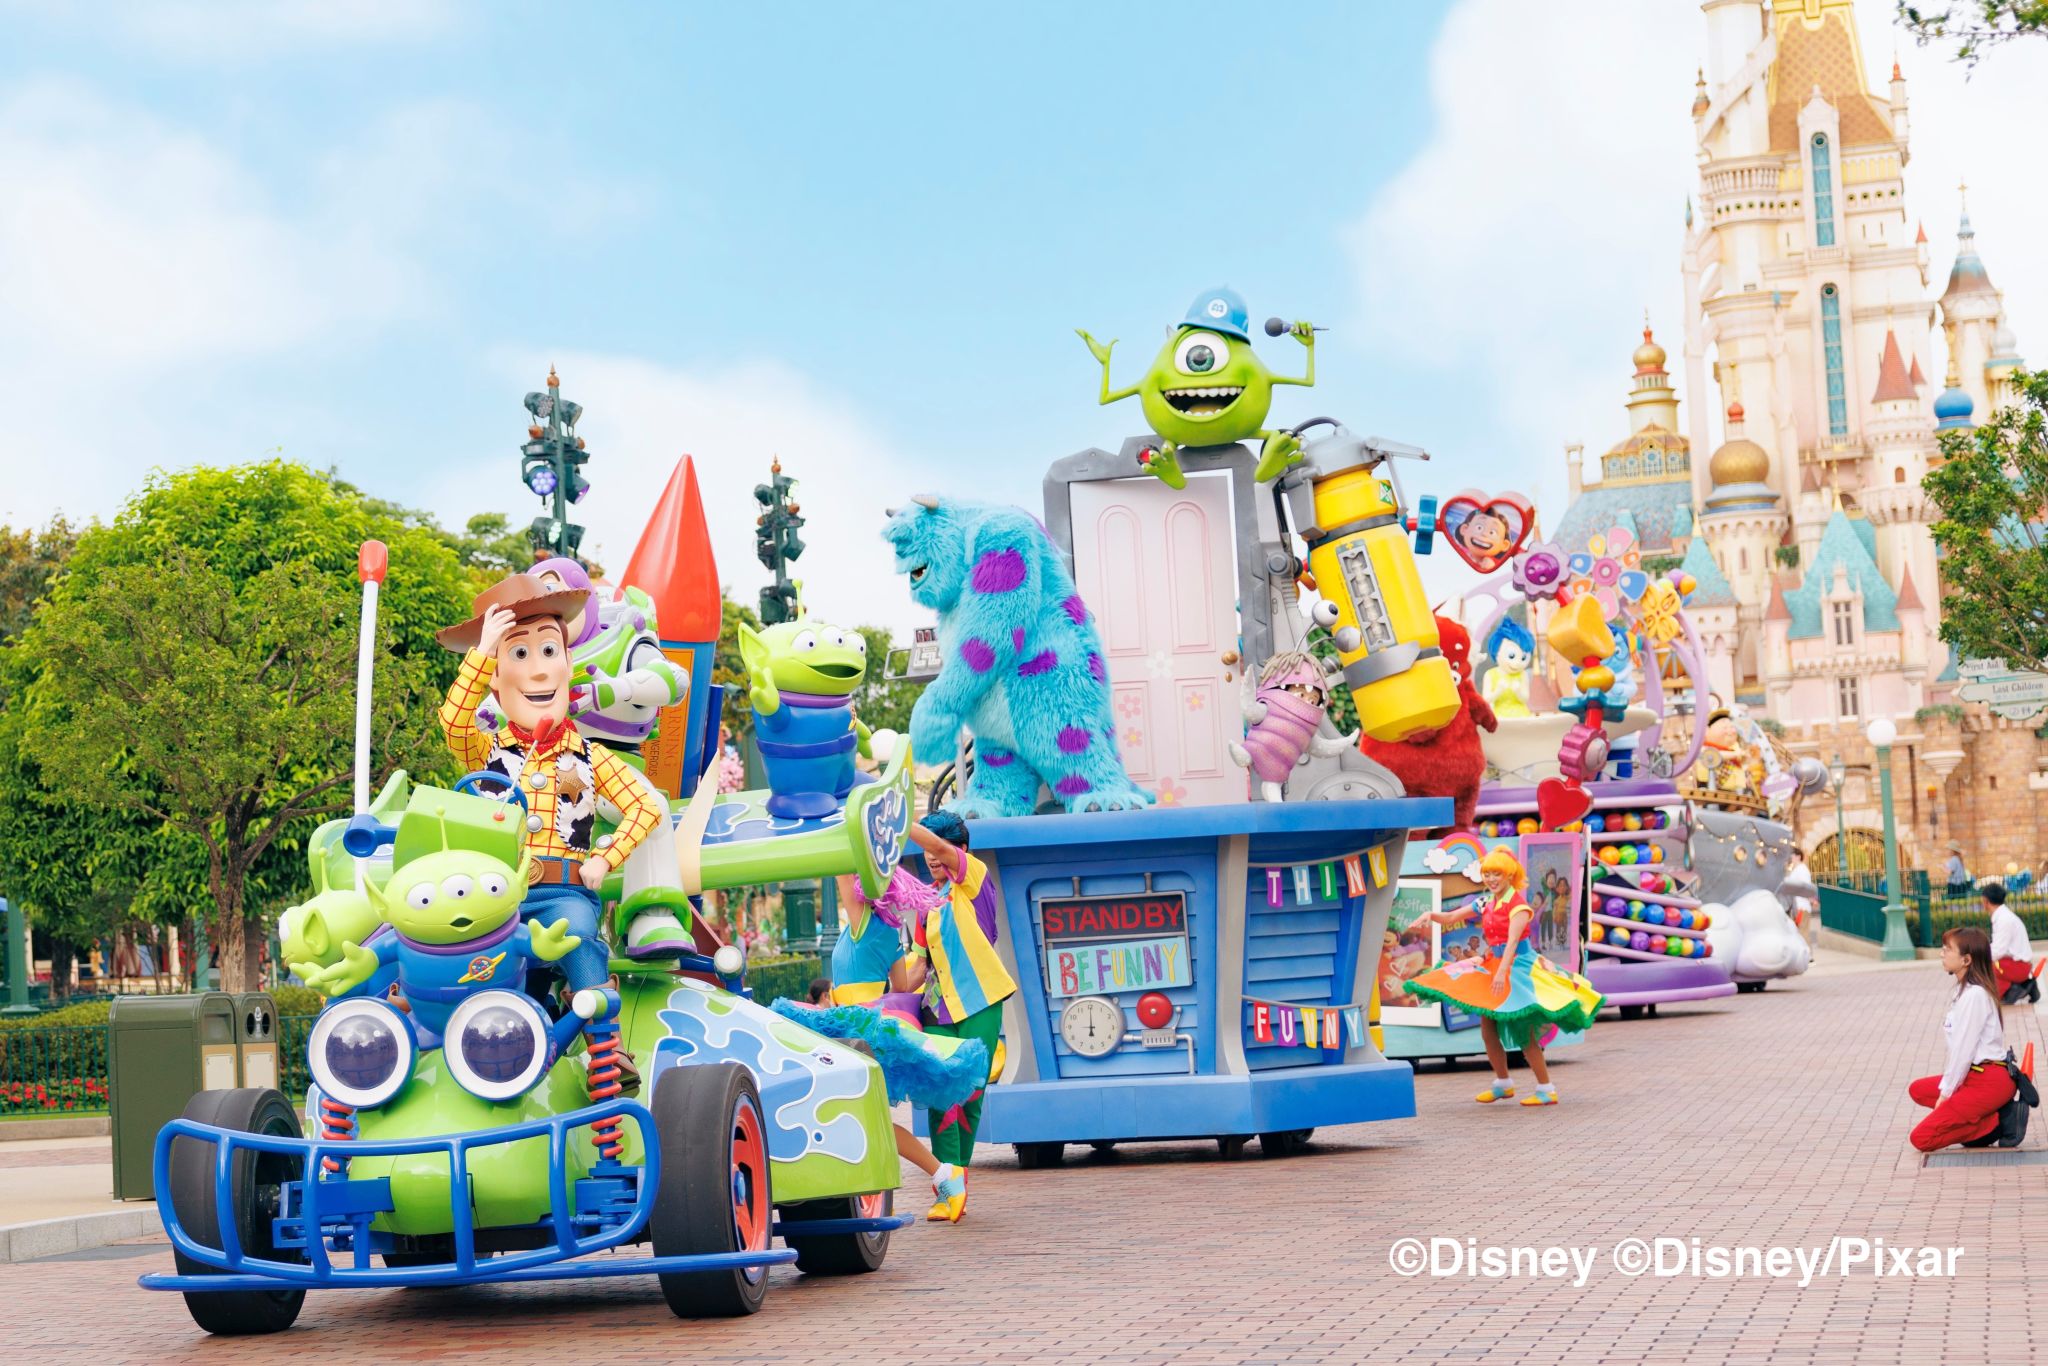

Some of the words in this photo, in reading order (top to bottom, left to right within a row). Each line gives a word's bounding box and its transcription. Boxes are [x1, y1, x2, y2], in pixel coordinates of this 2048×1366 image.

[2011, 682, 2044, 691] Children
[648, 737, 661, 777] NGEROUS
[663, 706, 683, 768] ARNING
[1268, 850, 1386, 904] THINK
[1059, 950, 1094, 995] BE
[1096, 943, 1179, 991] FUNNY
[1257, 1007, 1360, 1046] FUNNY
